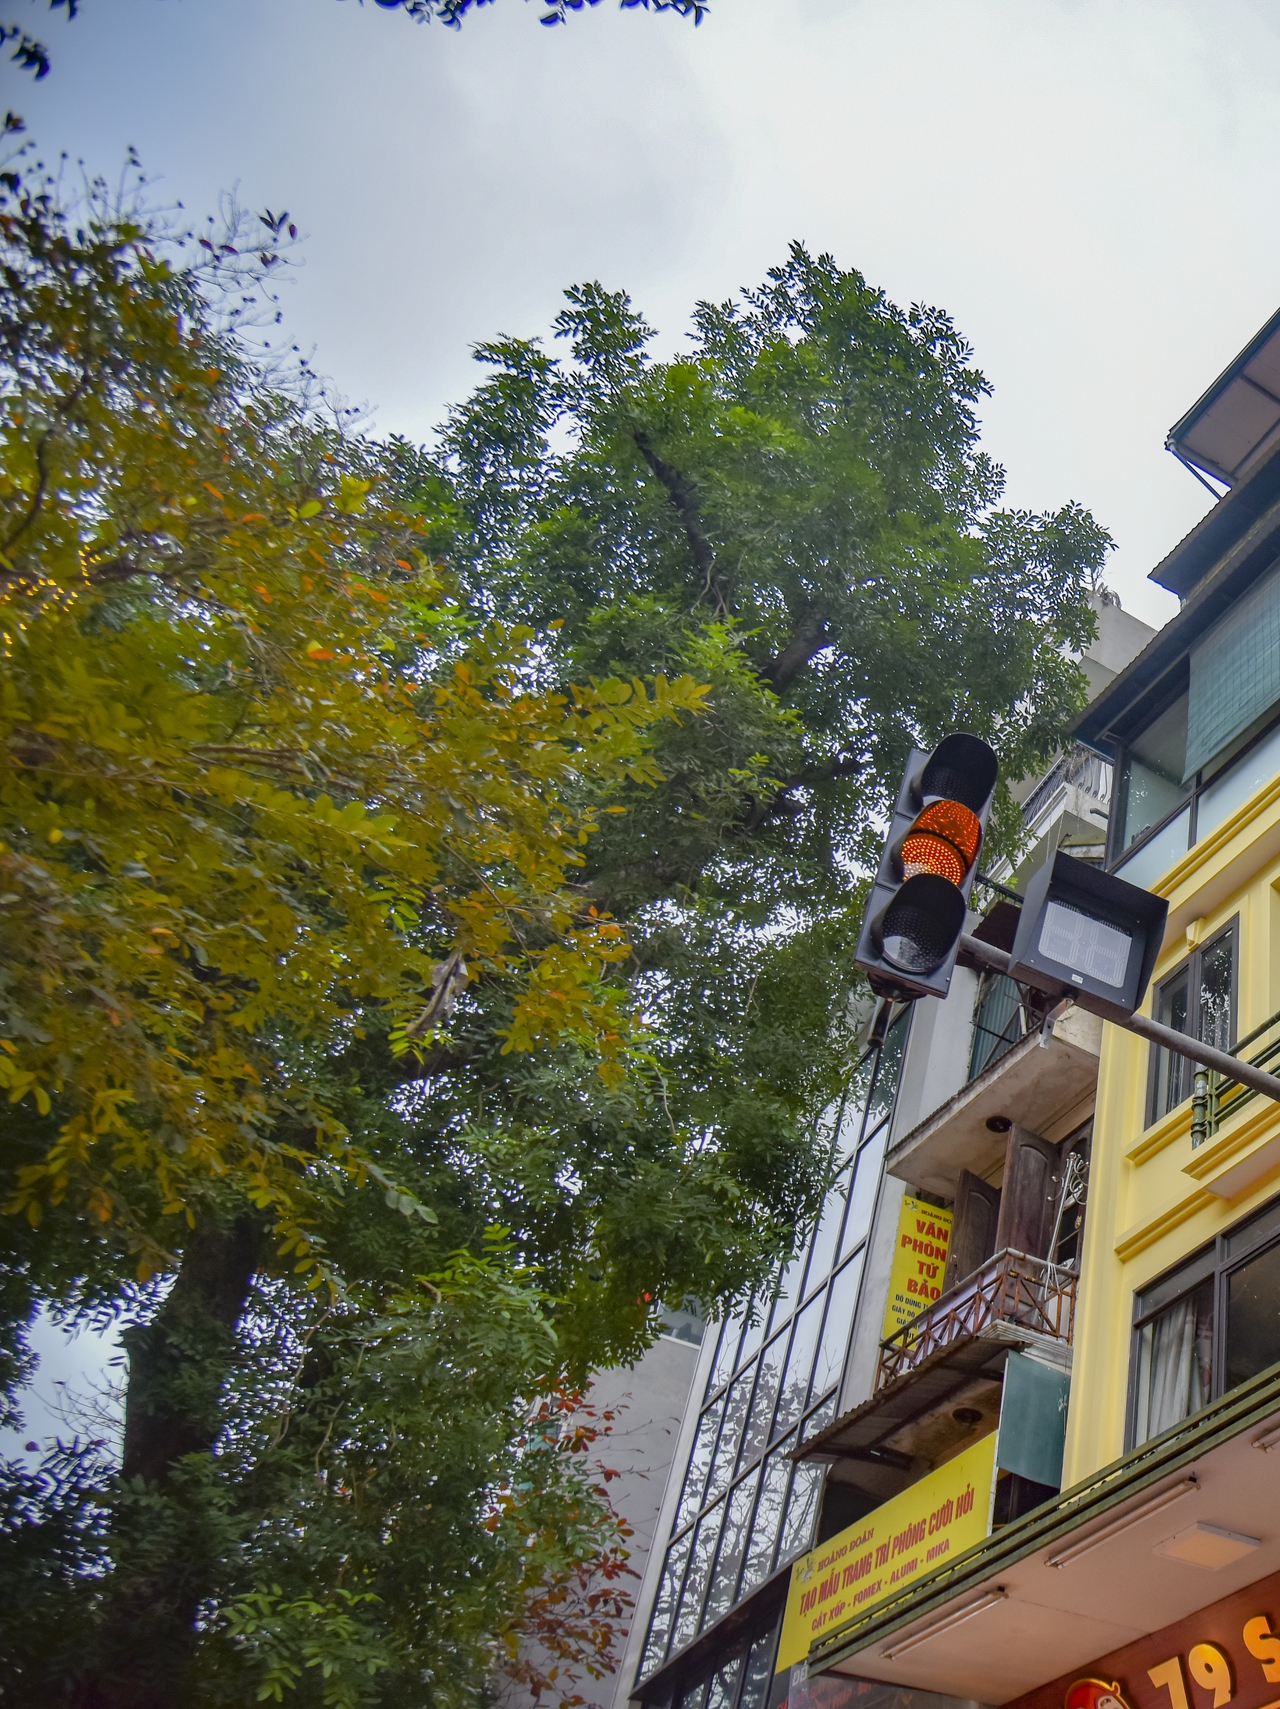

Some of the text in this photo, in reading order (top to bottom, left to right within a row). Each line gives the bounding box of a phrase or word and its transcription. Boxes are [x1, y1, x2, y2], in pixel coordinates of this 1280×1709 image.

[916, 1219, 949, 1243] VĂN
[901, 1234, 947, 1262] PHÒN
[917, 1260, 940, 1279] TỨ
[907, 1278, 941, 1301] BẢO
[799, 1587, 818, 1618] TẠO
[842, 1552, 873, 1590] TRANG
[874, 1535, 892, 1570] TRÍ
[891, 1518, 927, 1559] PHÔNG
[928, 1498, 954, 1536] CƯỚI
[955, 1483, 975, 1520] HỎI
[853, 1579, 882, 1607] FOMEX
[889, 1557, 918, 1585] ALUMI
[926, 1538, 950, 1563] MIKA
[1147, 1643, 1235, 1709] 79
